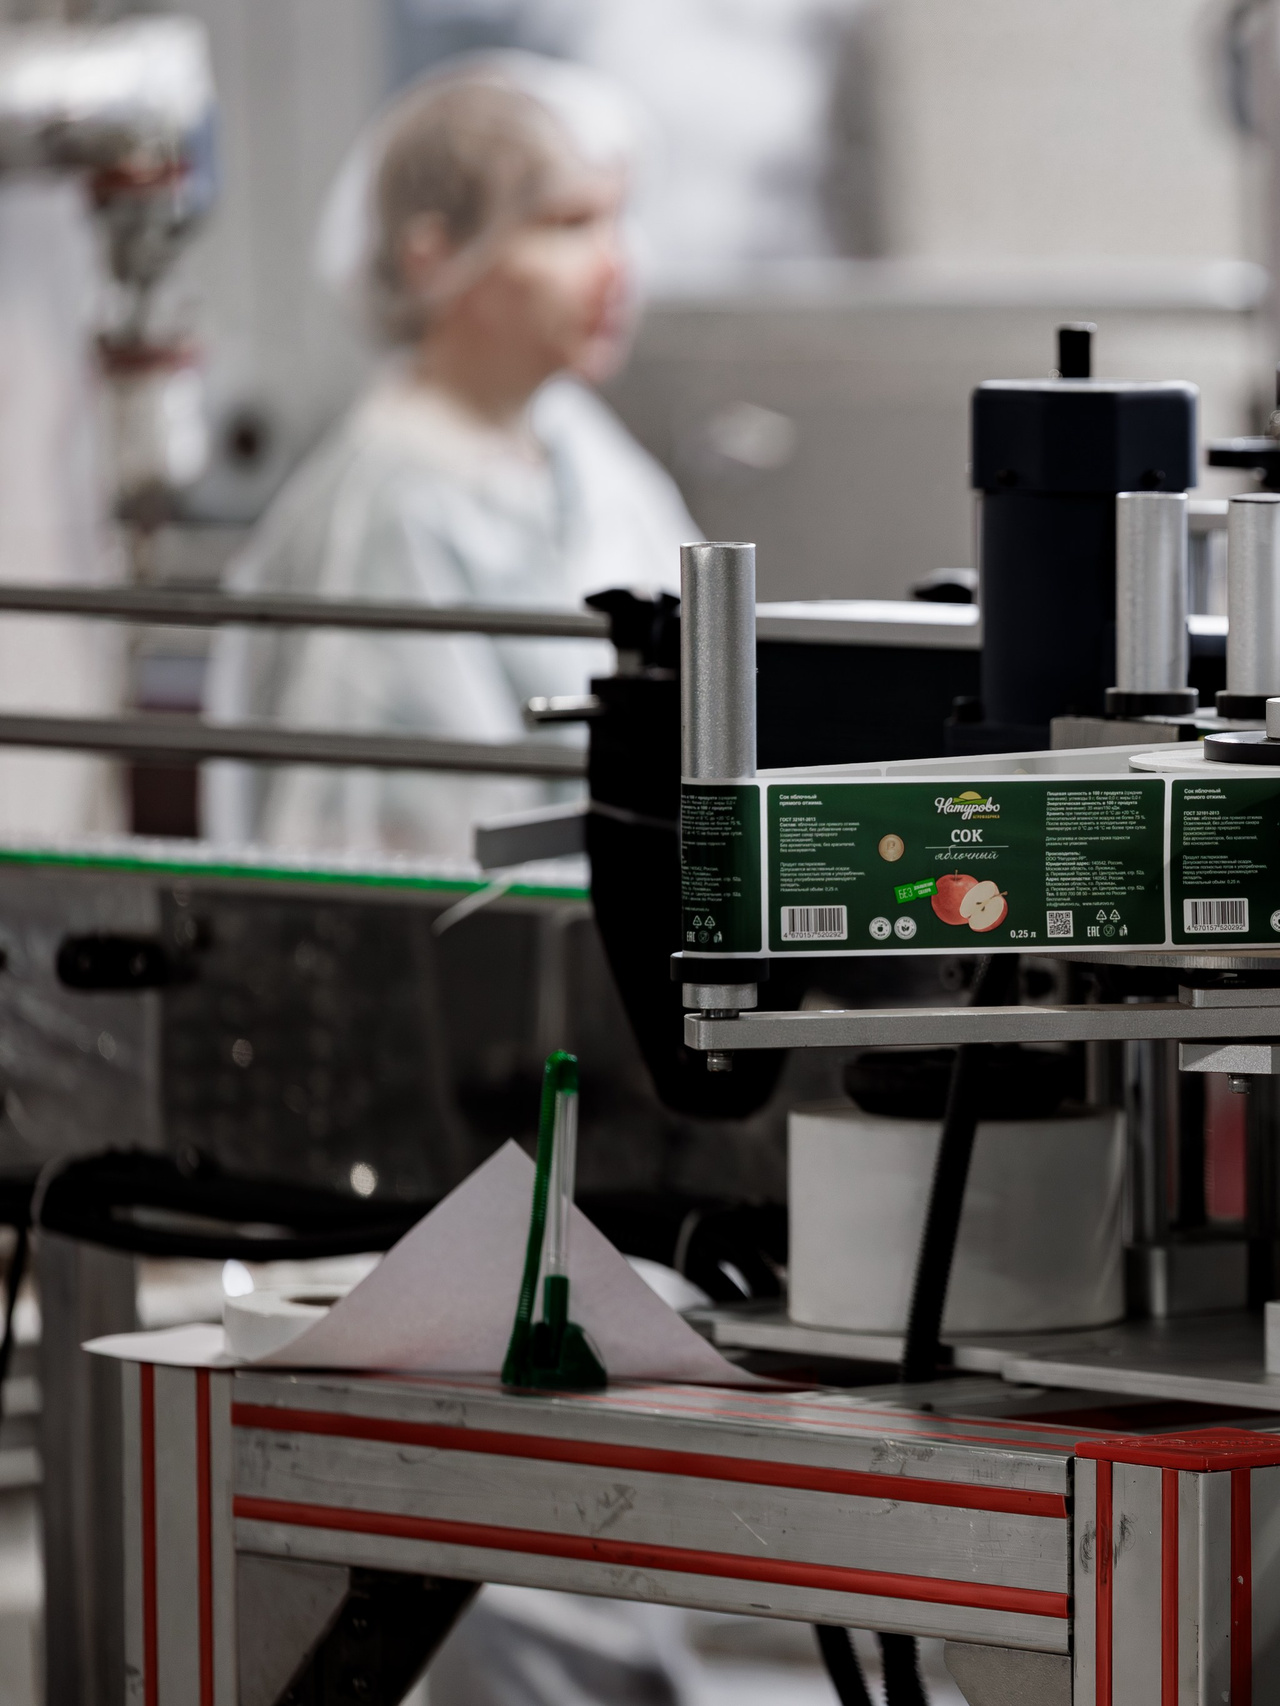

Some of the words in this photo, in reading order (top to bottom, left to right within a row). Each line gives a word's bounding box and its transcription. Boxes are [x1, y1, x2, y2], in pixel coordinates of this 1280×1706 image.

[934, 796, 1000, 820] Натурово
[950, 829, 983, 842] СОК
[934, 844, 999, 860] яблочный
[898, 887, 914, 900] БЕЗ
[1010, 930, 1029, 938] 0,25
